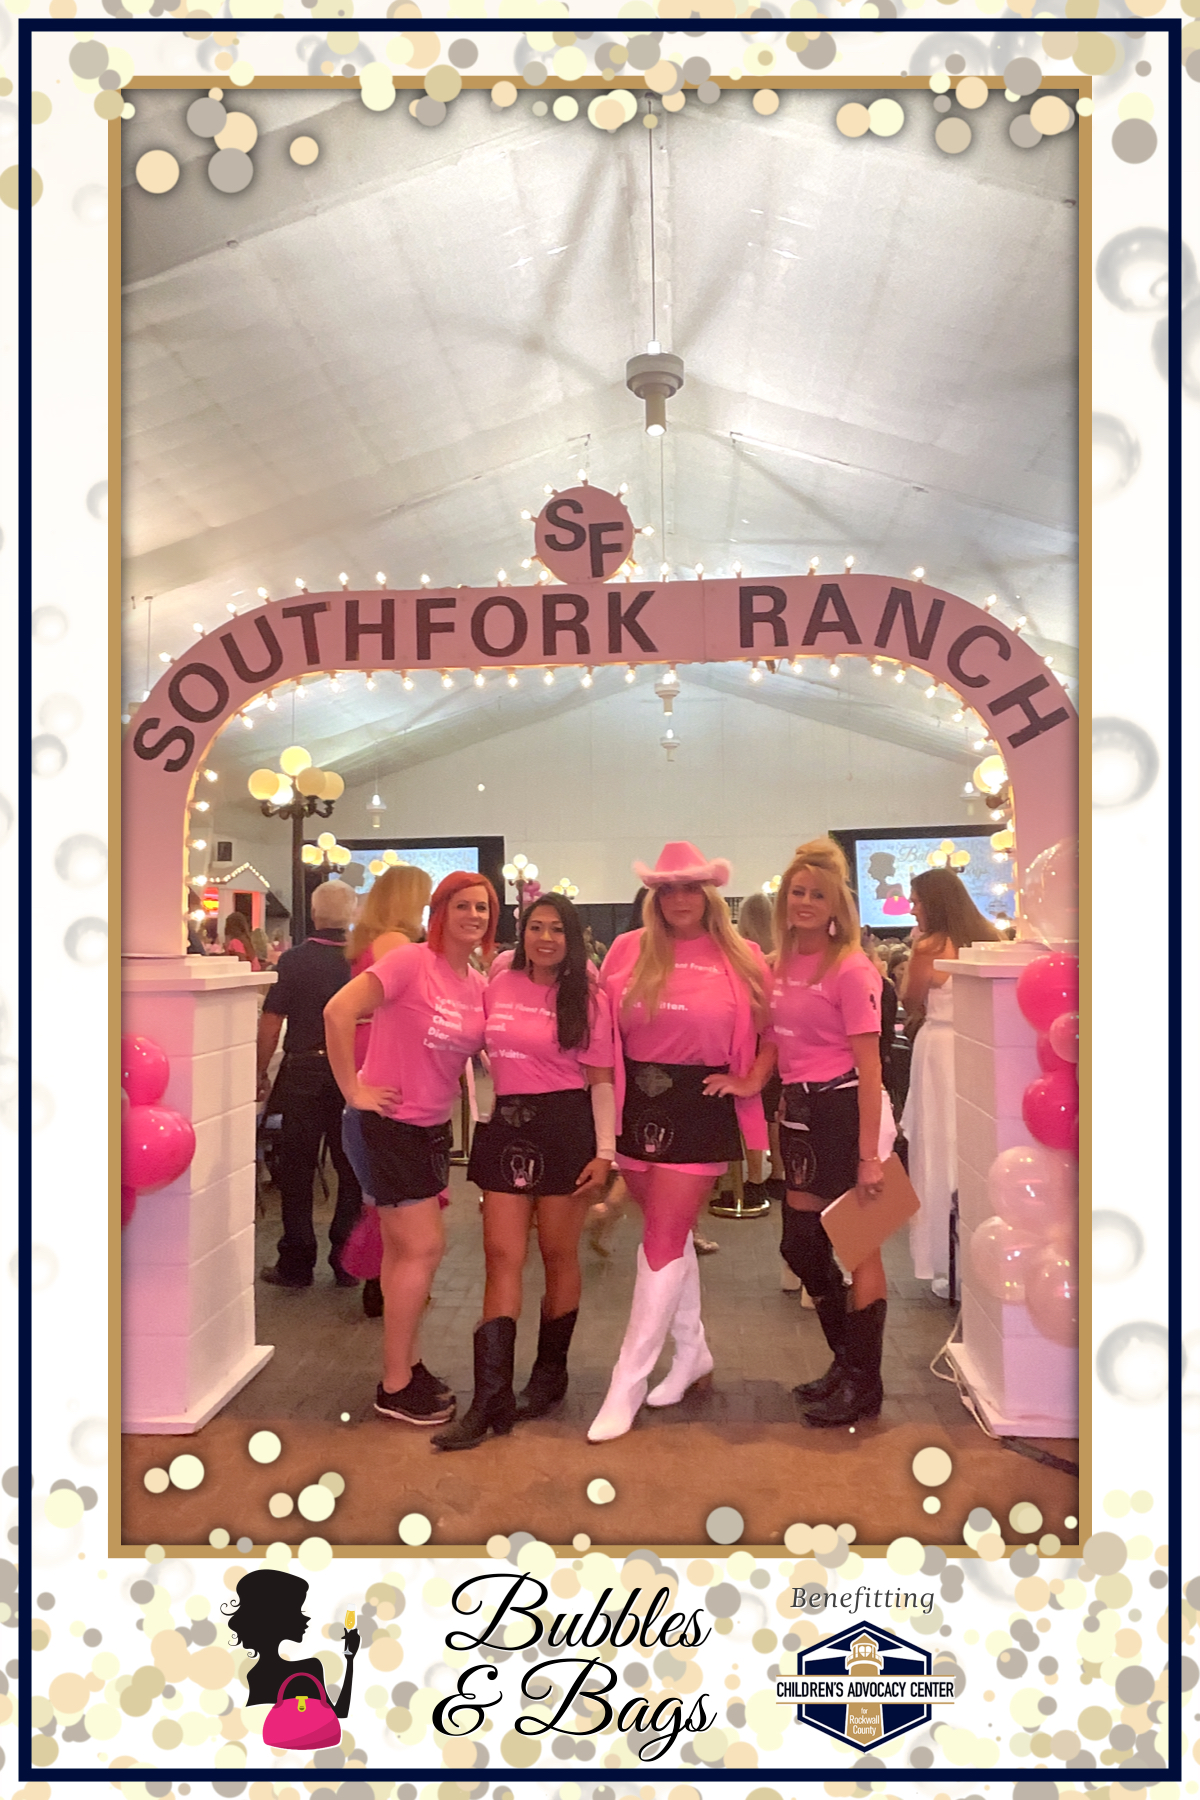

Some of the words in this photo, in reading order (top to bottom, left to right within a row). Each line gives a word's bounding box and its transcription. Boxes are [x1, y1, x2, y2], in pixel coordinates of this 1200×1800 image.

[544, 499, 624, 578] SF
[133, 590, 659, 773] SOUTHFORK
[738, 583, 1070, 749] RANCH
